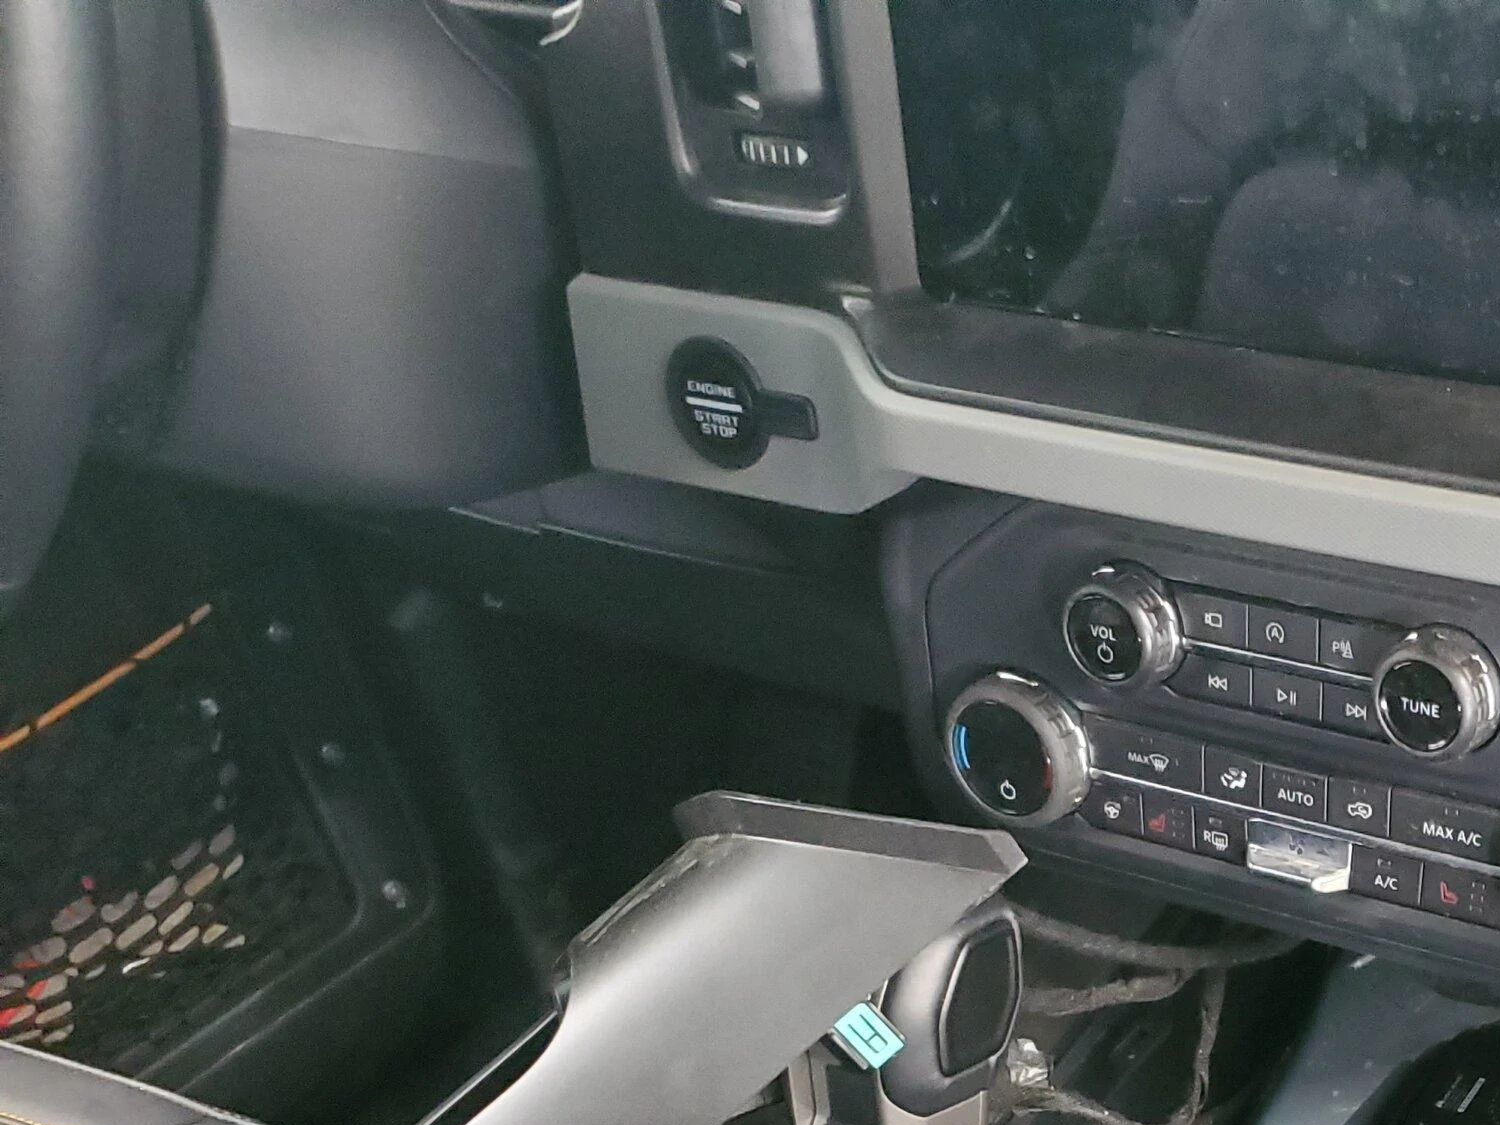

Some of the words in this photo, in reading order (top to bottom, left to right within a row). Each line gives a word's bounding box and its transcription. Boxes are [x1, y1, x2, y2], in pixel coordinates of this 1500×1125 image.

[686, 380, 737, 399] ENGINE
[693, 409, 740, 428] START
[701, 422, 738, 438] STOP
[1090, 624, 1116, 642] VOL
[1400, 696, 1440, 718] TUNE
[1127, 751, 1150, 765] MAX
[1277, 788, 1314, 807] AUTO
[1423, 821, 1454, 841] MAX
[1457, 829, 1482, 848] A/C
[1374, 874, 1399, 891] A/C
